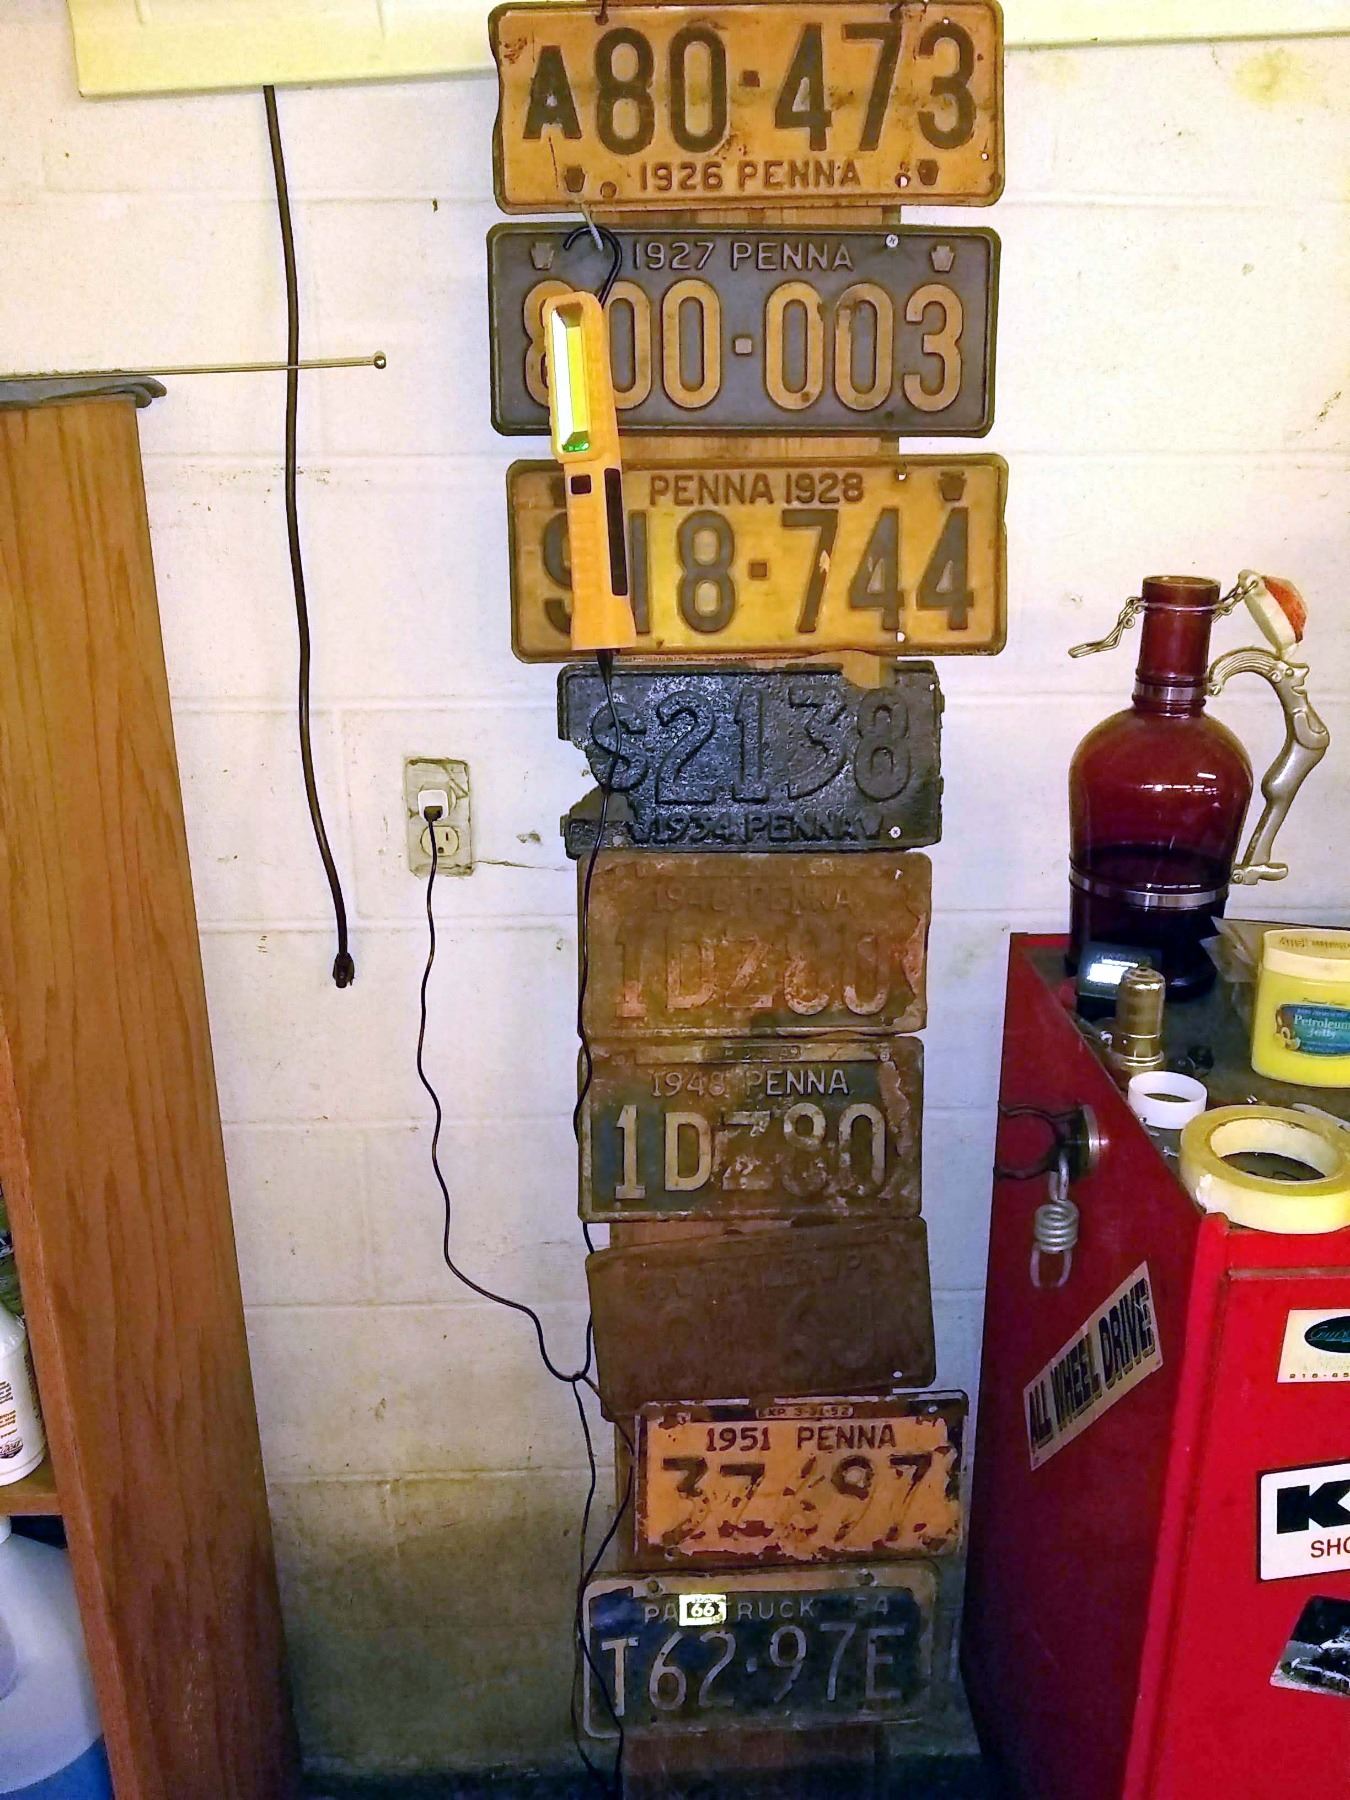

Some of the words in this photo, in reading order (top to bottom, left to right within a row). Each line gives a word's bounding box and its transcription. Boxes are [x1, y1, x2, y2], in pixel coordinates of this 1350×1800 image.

[639, 160, 724, 192] 1926
[737, 159, 861, 191] PENNA
[632, 241, 714, 271] 1927
[730, 241, 855, 271] PENNA
[649, 473, 774, 506] PENNA
[784, 472, 865, 504] 1928
[746, 1068, 849, 1096] PENNA
[1050, 1334, 1103, 1432] WHEEL
[1099, 1277, 1156, 1391] DRIVE
[706, 1427, 771, 1452] 1951
[797, 1424, 897, 1450] PENNA
[690, 1603, 715, 1618] 66
[727, 1600, 815, 1621] RUCK
